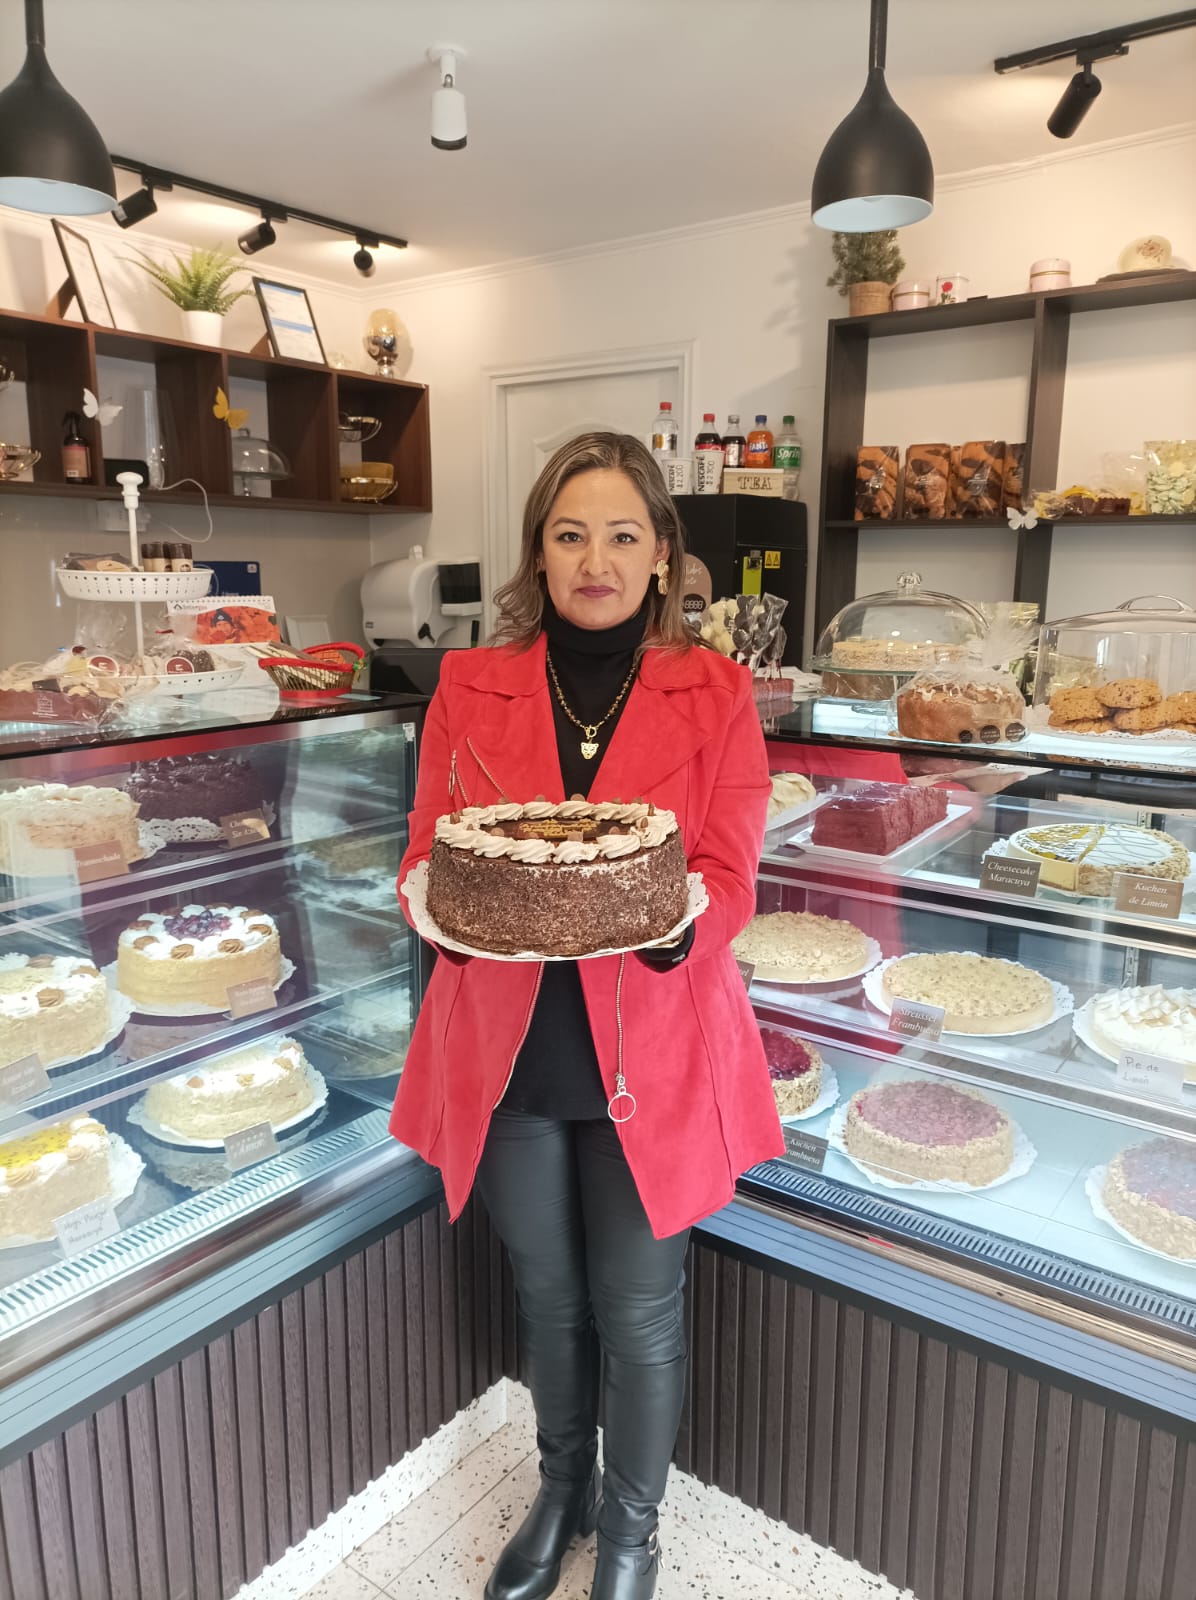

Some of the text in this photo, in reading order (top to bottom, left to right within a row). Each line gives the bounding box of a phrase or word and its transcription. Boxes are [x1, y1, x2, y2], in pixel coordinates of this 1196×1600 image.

[696, 455, 705, 492] NESCAFÉ
[737, 476, 773, 490] TEA
[987, 861, 1037, 876] Cheesecake
[1133, 882, 1168, 894] Kuchen
[1128, 895, 1139, 905] de
[790, 1138, 817, 1153] Kuchen
[786, 1149, 821, 1165] rambuesa
